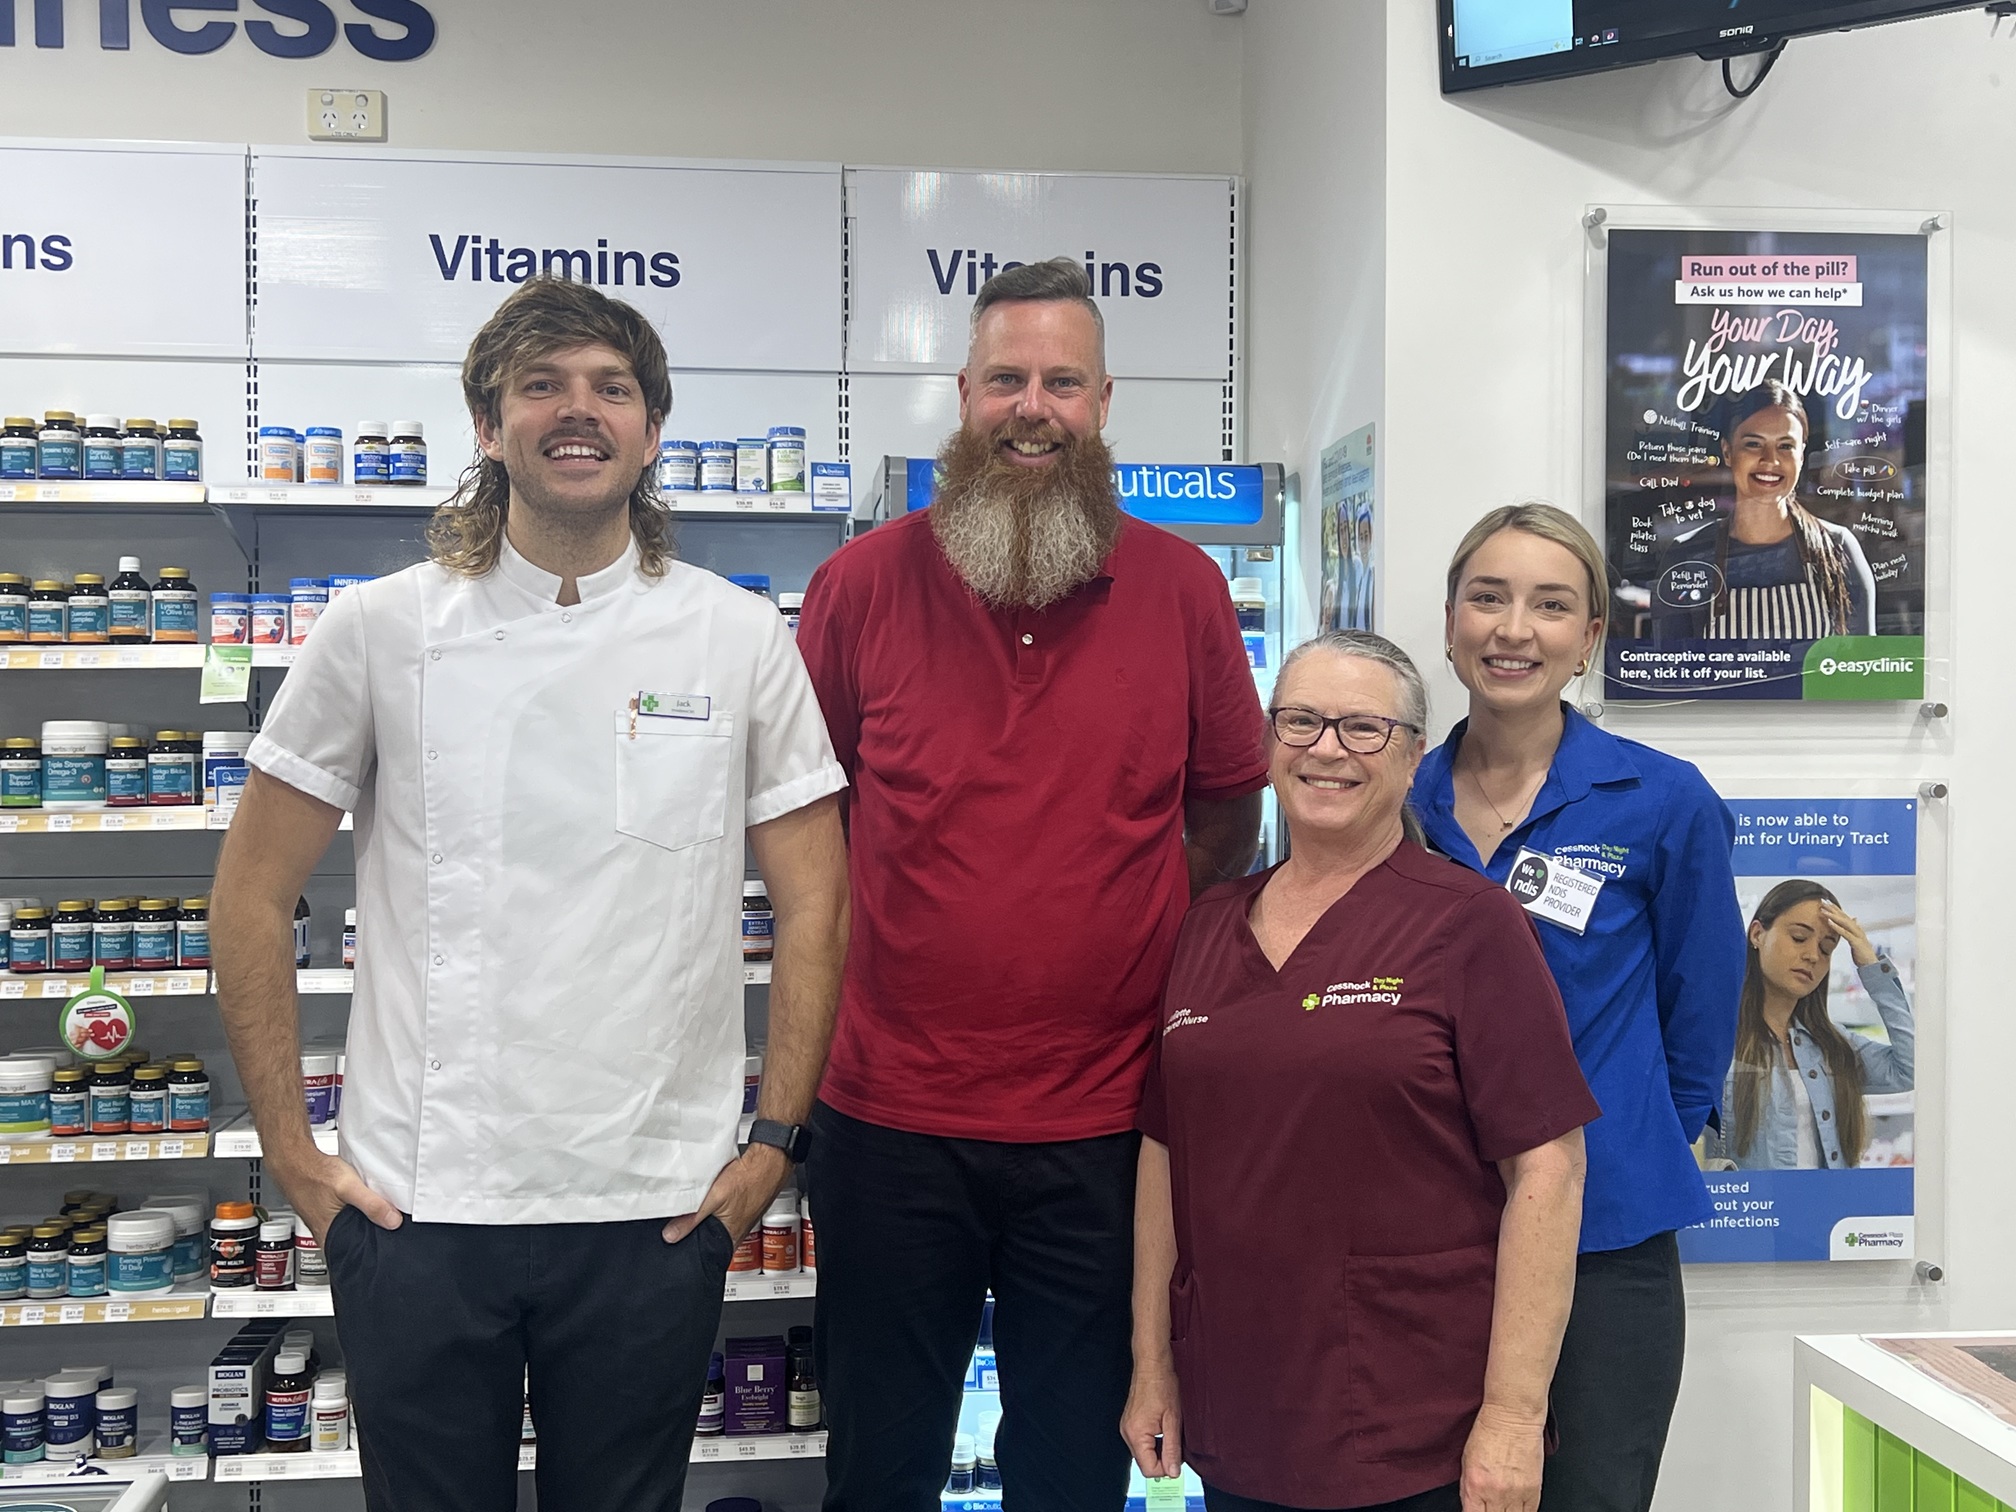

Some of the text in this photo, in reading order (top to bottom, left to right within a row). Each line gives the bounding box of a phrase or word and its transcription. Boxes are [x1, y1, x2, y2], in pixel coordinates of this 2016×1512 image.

[429, 234, 682, 287] Vitamins
[927, 249, 1163, 298] Vitins
[1691, 262, 1848, 279] Run out of the pill?
[1691, 287, 1715, 297] Ask
[1719, 289, 1733, 297] us
[1738, 287, 1763, 298] how
[1768, 289, 1785, 298] we
[1789, 289, 1810, 298] can
[1708, 308, 1772, 353] Your
[1677, 339, 1872, 419] Your Way
[1873, 404, 1898, 412] Dinner
[1659, 415, 1720, 441] Netball Training
[1871, 415, 1883, 423] the
[1886, 415, 1901, 427] girls
[1865, 432, 1886, 447] night
[1639, 441, 1707, 456] Return those jeans
[1669, 454, 1689, 462] them
[1843, 463, 1876, 476] Take pill
[1640, 477, 1679, 489] Call Dad
[1817, 486, 1904, 502] Complete budget plan
[1658, 497, 1716, 517] Take dog
[1632, 516, 1653, 528] Book
[1675, 510, 1703, 524] to vet
[1861, 512, 1894, 528] Morning
[1853, 523, 1879, 535] matcha
[1630, 531, 1656, 543] pilates
[1630, 544, 1648, 553] class
[1872, 554, 1906, 572] Plan next
[1671, 571, 1707, 581] Refill pill
[1620, 651, 1790, 663] Contraceptive care available
[1837, 658, 1913, 675] easyclinic
[1620, 667, 1767, 681] here, tick it off your list.
[64, 761, 93, 769] Strength
[48, 769, 77, 777] Omega-3
[1739, 813, 1849, 826] is now able to
[1760, 832, 1782, 844] for
[1788, 832, 1845, 847] Urinary
[1851, 832, 1889, 844] Tract
[1555, 844, 1600, 854] Cessnock
[1521, 863, 1535, 877] We
[1553, 855, 1626, 878] Pharmacy
[1514, 878, 1539, 897] ndis
[1549, 884, 1567, 898] NDIS
[1553, 873, 1598, 896] REGISTERED
[1543, 895, 1582, 918] PROVIDER
[1327, 981, 1370, 992] Cessnock
[1322, 992, 1401, 1007] Pharmacy
[1181, 1016, 1208, 1026] Nurse
[1714, 1200, 1774, 1212] out your
[1858, 1238, 1903, 1247] Pharmacy
[735, 1385, 774, 1394] Blue Berry
